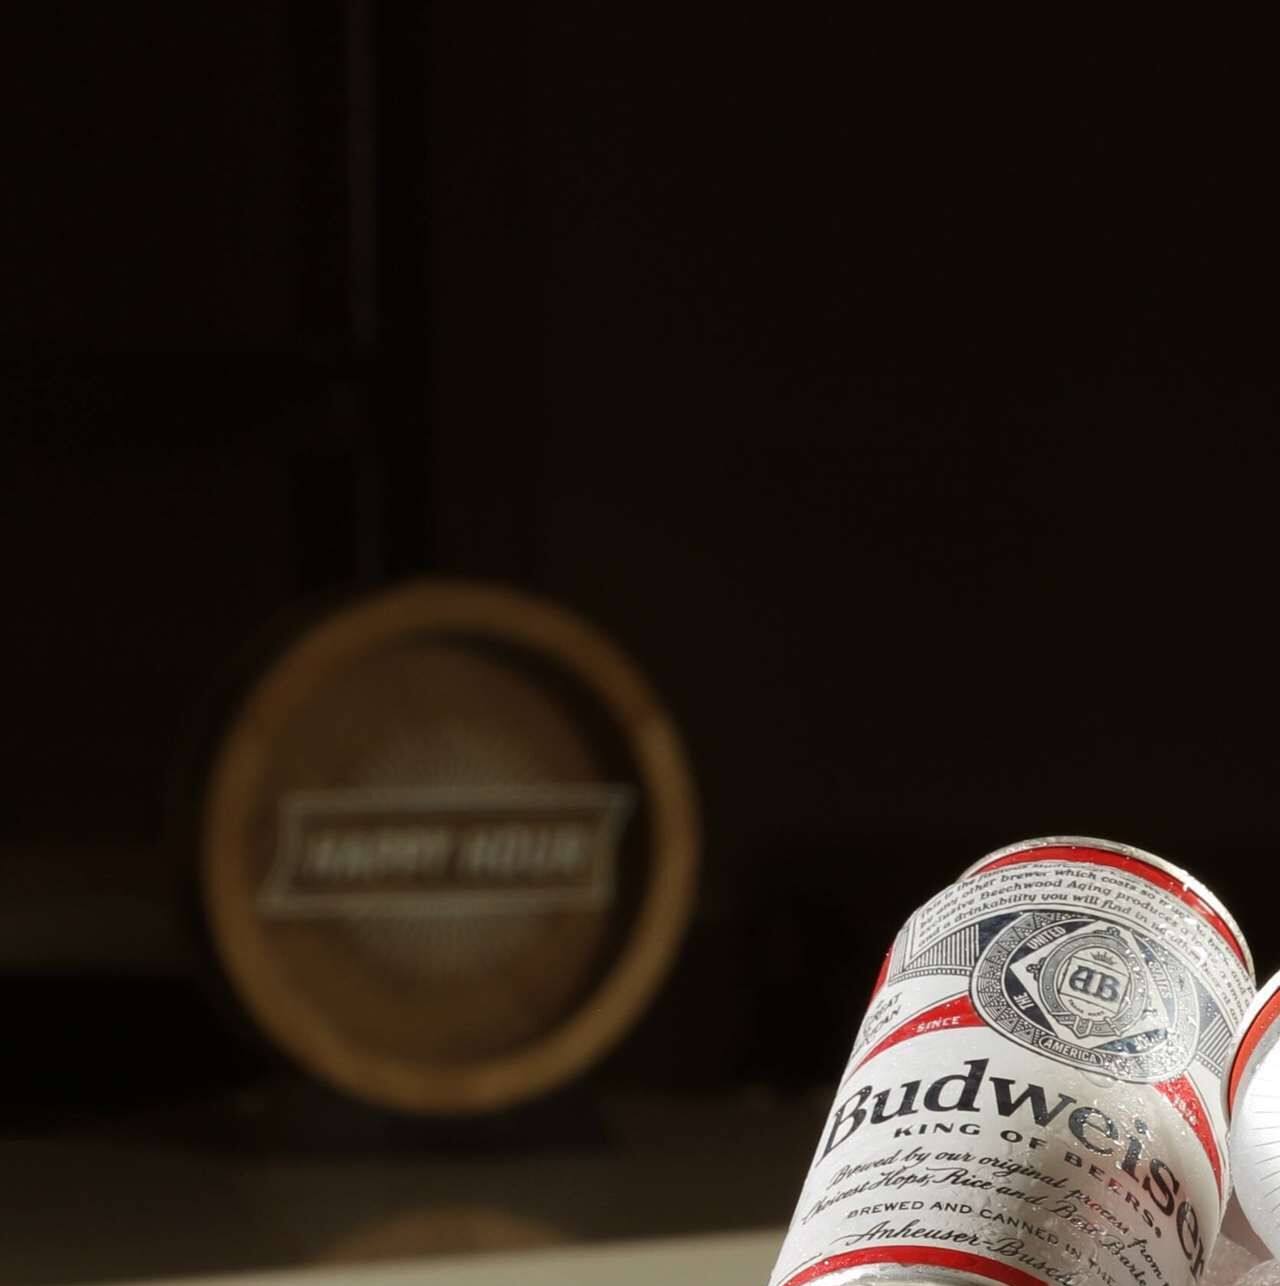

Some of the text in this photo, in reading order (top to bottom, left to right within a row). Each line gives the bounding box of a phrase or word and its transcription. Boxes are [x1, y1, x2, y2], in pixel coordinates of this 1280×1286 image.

[961, 879, 996, 898] other
[1054, 868, 1098, 882] which
[1100, 874, 1137, 892] costs
[1140, 887, 1157, 901] so
[954, 892, 1039, 922] drinkability
[1040, 893, 1068, 902] you
[1072, 893, 1100, 906] will
[1101, 899, 1132, 916] find
[1134, 911, 1149, 925] in
[980, 879, 1062, 899] Beechwood
[1067, 880, 1113, 898] Aging
[1115, 892, 1178, 929] produces
[1026, 925, 1067, 950] UNITED
[1013, 991, 1036, 1011] THE
[915, 1015, 961, 1034] SINCE
[1044, 1037, 1099, 1064] AMERICA
[893, 1122, 982, 1139] KING
[1000, 1129, 1048, 1150] OF
[814, 1057, 1205, 1283] Budweiser
[873, 1166, 932, 1191] Hops,
[925, 1166, 999, 1191] Rice
[995, 1184, 1053, 1208] and
[825, 1149, 903, 1191] Brewed
[903, 1146, 932, 1169] by
[934, 1150, 977, 1163] our
[977, 1154, 1072, 1191] original
[1063, 1188, 1130, 1235] process
[1127, 1237, 1163, 1281] from
[846, 1199, 925, 1221] BREWED
[930, 1200, 973, 1215] AND
[979, 1208, 1060, 1246] CANNED
[1064, 1243, 1082, 1261] IN
